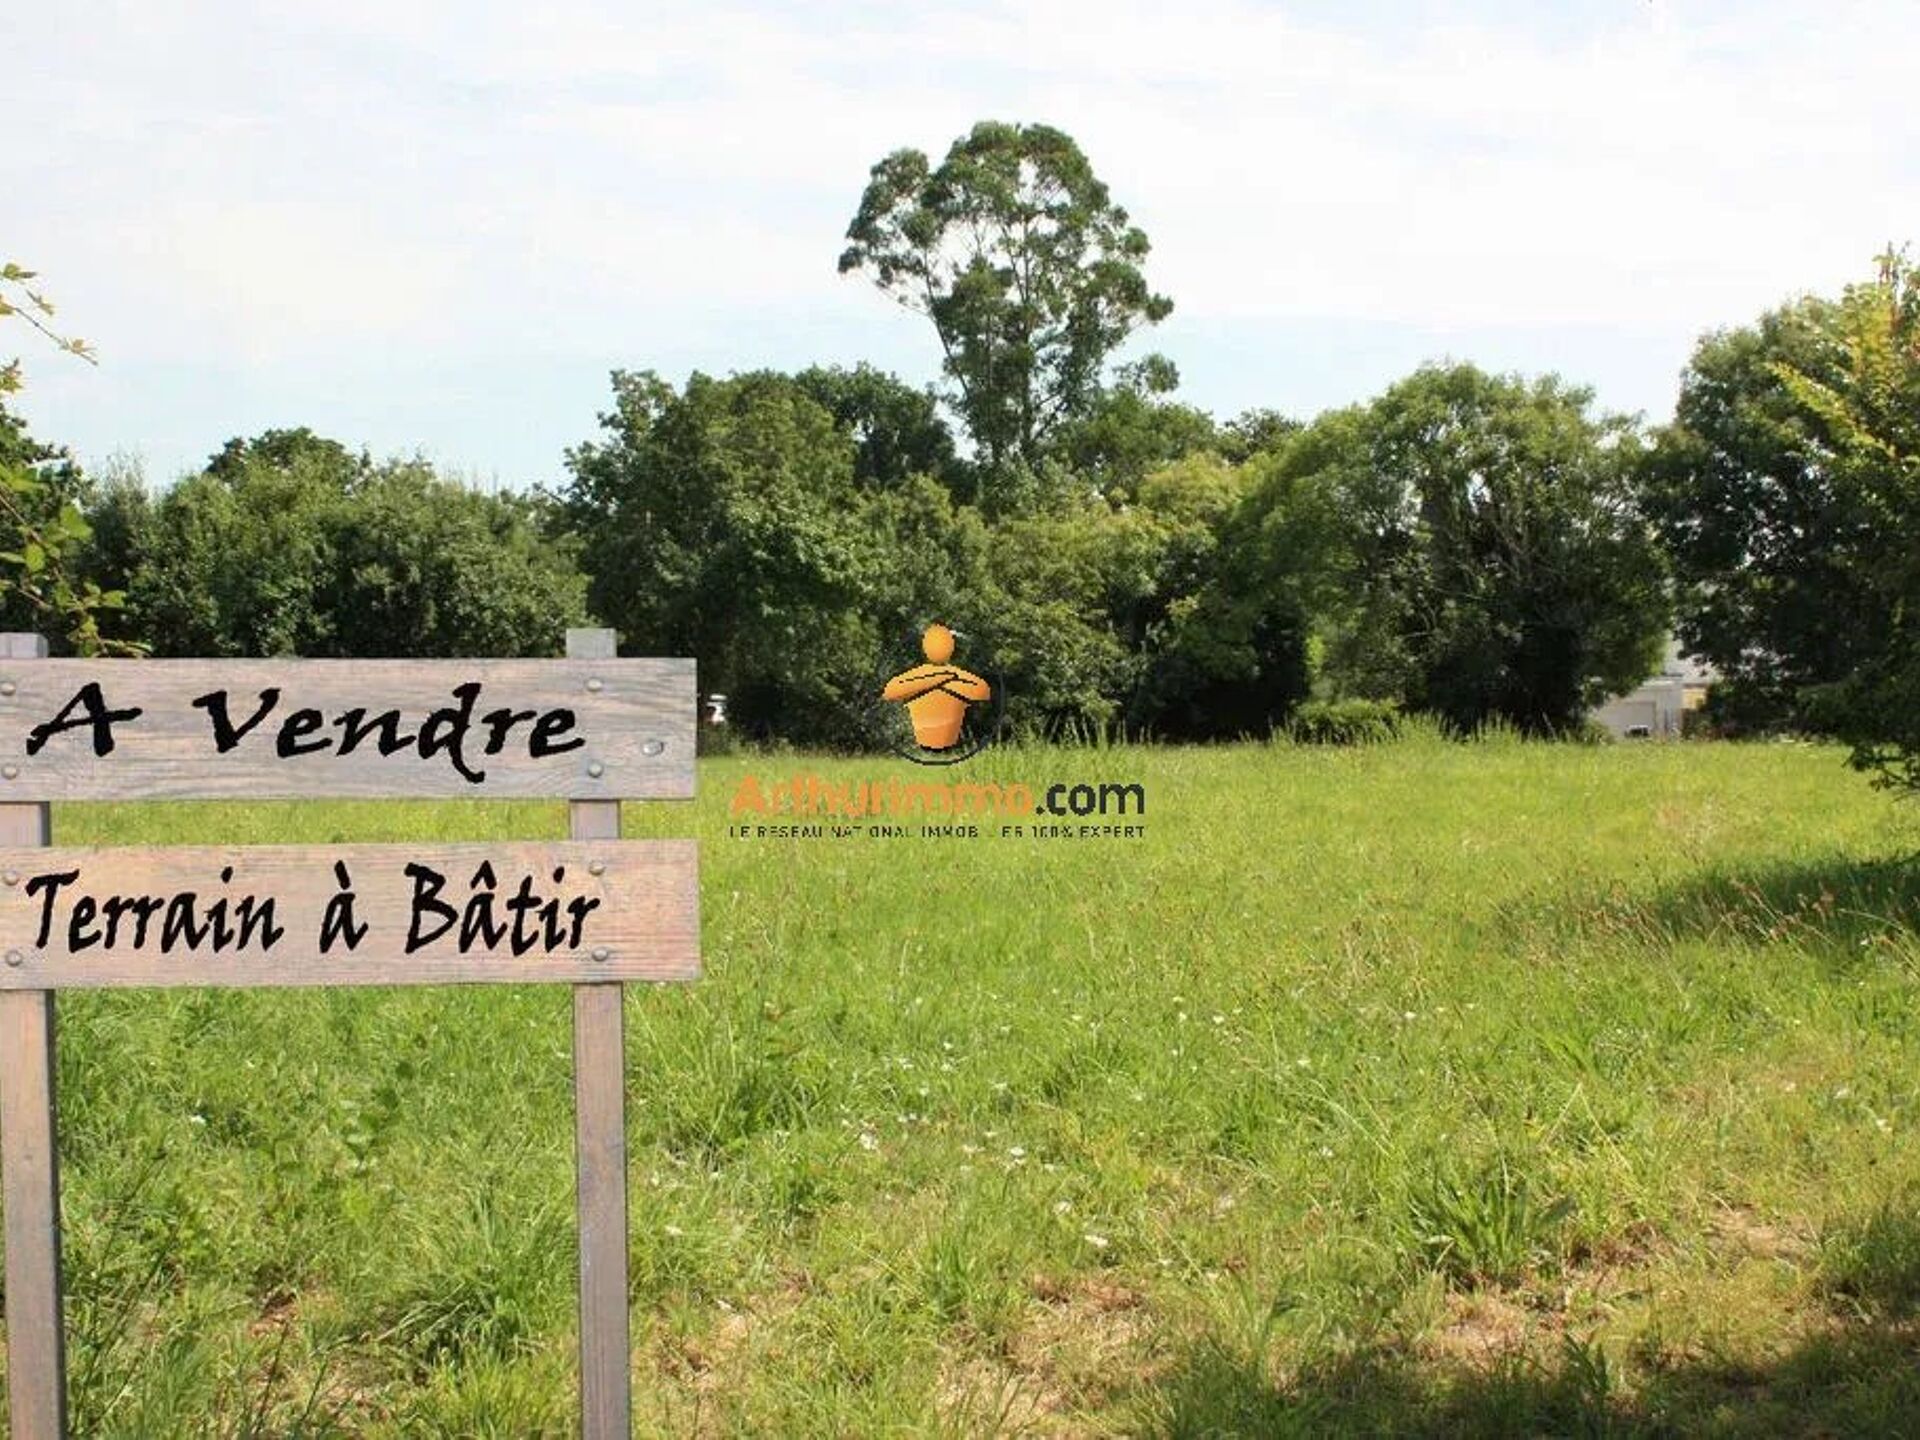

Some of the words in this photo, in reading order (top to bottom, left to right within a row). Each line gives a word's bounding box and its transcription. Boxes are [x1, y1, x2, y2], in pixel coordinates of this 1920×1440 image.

[26, 682, 143, 758] A
[192, 682, 586, 785] Vendre
[25, 866, 285, 954] Terrain
[319, 860, 369, 954] à
[404, 860, 602, 957] Bâtir
